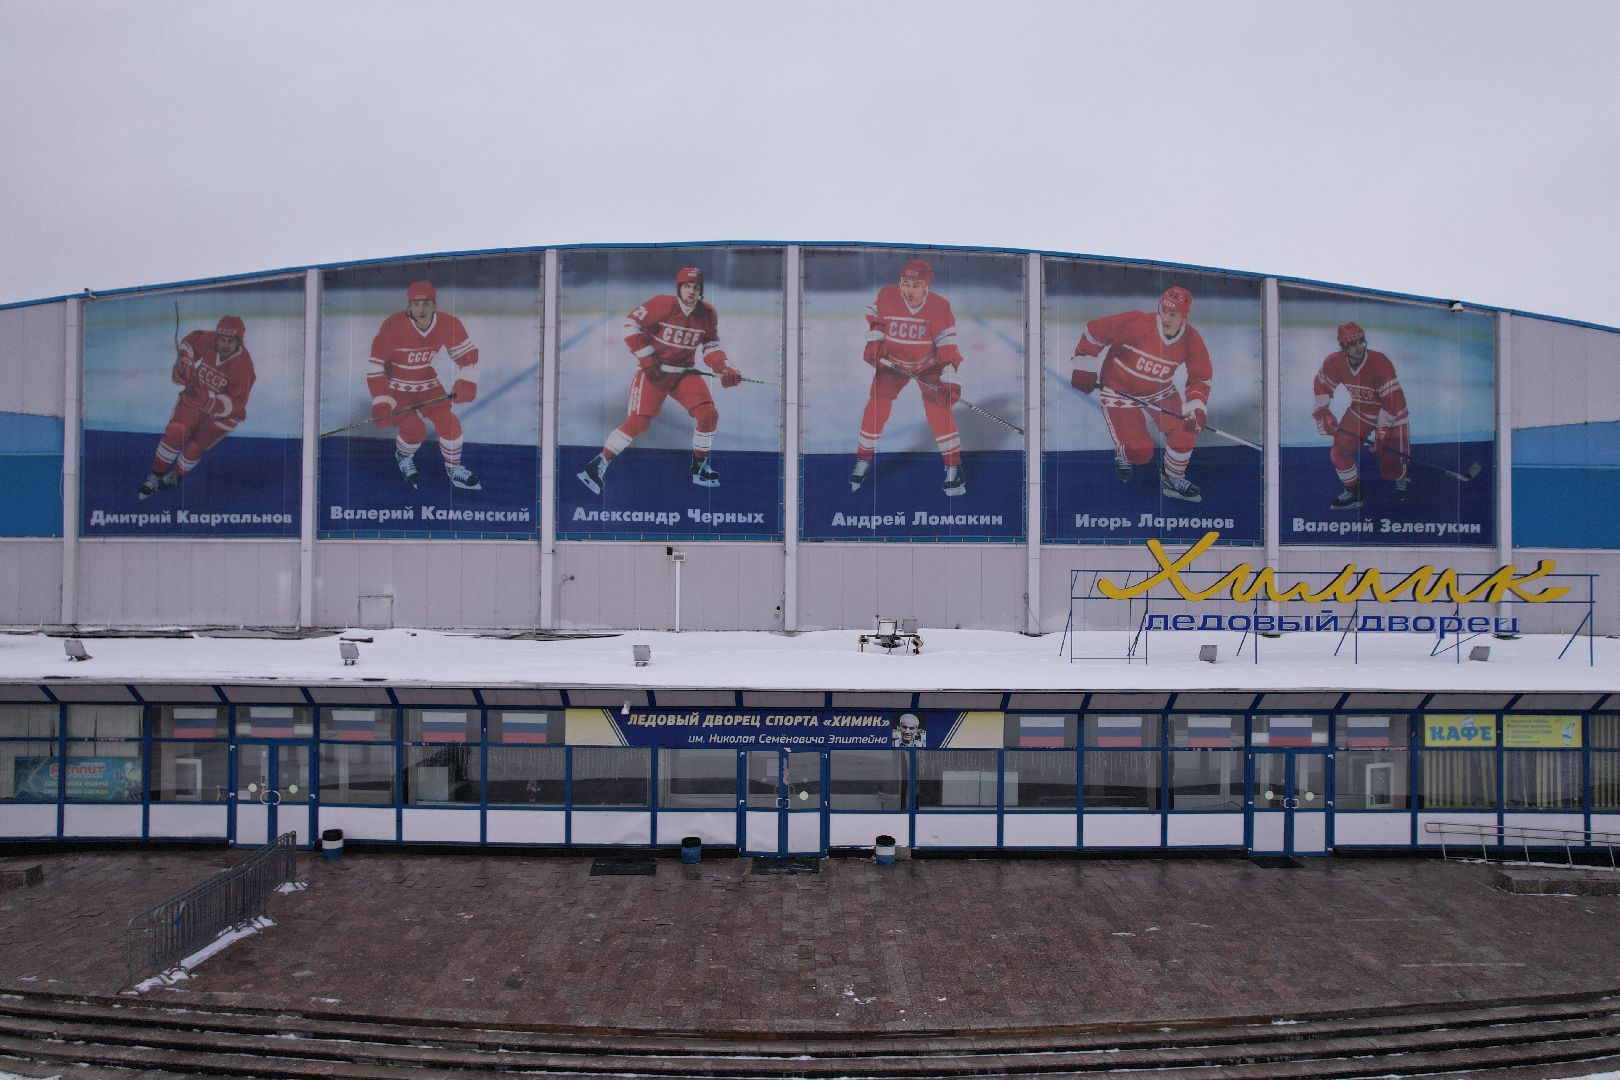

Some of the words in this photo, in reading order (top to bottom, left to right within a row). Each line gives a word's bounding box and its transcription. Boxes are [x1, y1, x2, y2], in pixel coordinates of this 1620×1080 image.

[662, 327, 700, 346] СССР
[889, 321, 926, 339] СССР
[1135, 357, 1171, 377] СССР
[198, 367, 228, 388] СССР
[90, 510, 171, 526] Дмитрий
[177, 510, 292, 526] Квартальнов
[330, 505, 414, 522] Валерий
[421, 505, 530, 522] Каменский
[572, 506, 680, 525] Александр
[687, 508, 765, 526] Черных
[831, 511, 906, 529] Андрей
[912, 511, 1003, 526] Ломакин
[1075, 513, 1132, 530] Игорь
[1138, 513, 1235, 531] Ларионов
[1292, 517, 1374, 535] Валерий
[1380, 518, 1481, 536] Зелепукин
[1097, 531, 1571, 603] Химик
[1145, 609, 1339, 632] ледовый
[1357, 614, 1520, 639] дворец
[628, 711, 699, 727] ЛЕДОВЫЙ
[702, 714, 761, 728] ДВОРЕЦ
[765, 715, 819, 727] СПОРТА
[823, 715, 891, 727] «ХИМИК»
[688, 735, 706, 743] им.
[709, 733, 755, 744] Николая
[758, 733, 825, 744] Семёновича
[828, 734, 888, 744] Эпштейна
[1429, 725, 1492, 742] КАФЕ
